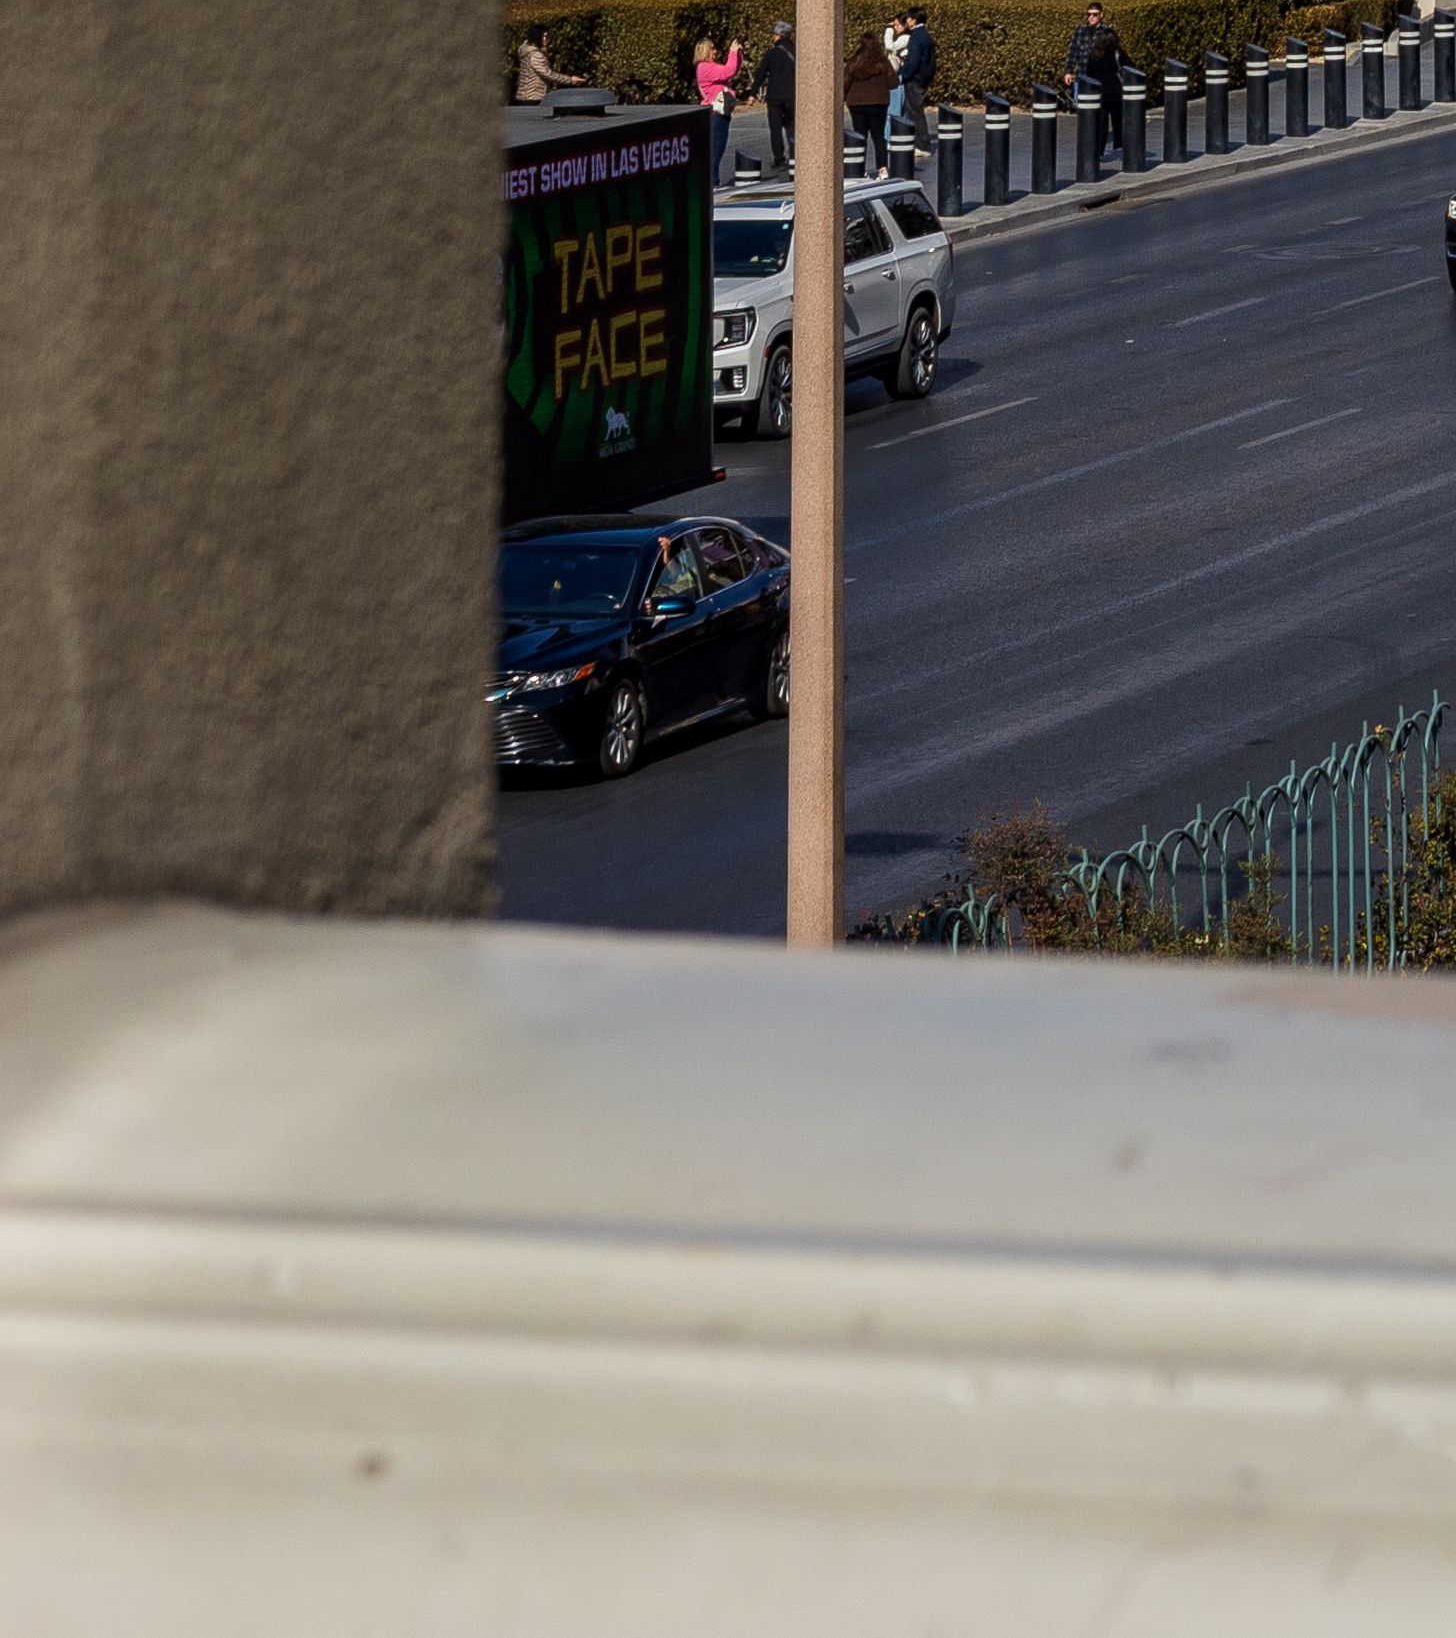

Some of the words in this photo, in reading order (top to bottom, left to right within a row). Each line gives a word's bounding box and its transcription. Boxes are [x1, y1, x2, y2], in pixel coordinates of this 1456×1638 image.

[541, 155, 588, 193] SHOW
[591, 151, 607, 182] IN
[611, 145, 639, 178] LAS
[642, 135, 690, 171] VEGAS
[554, 223, 663, 315] TAPE
[555, 309, 668, 400] FACE
